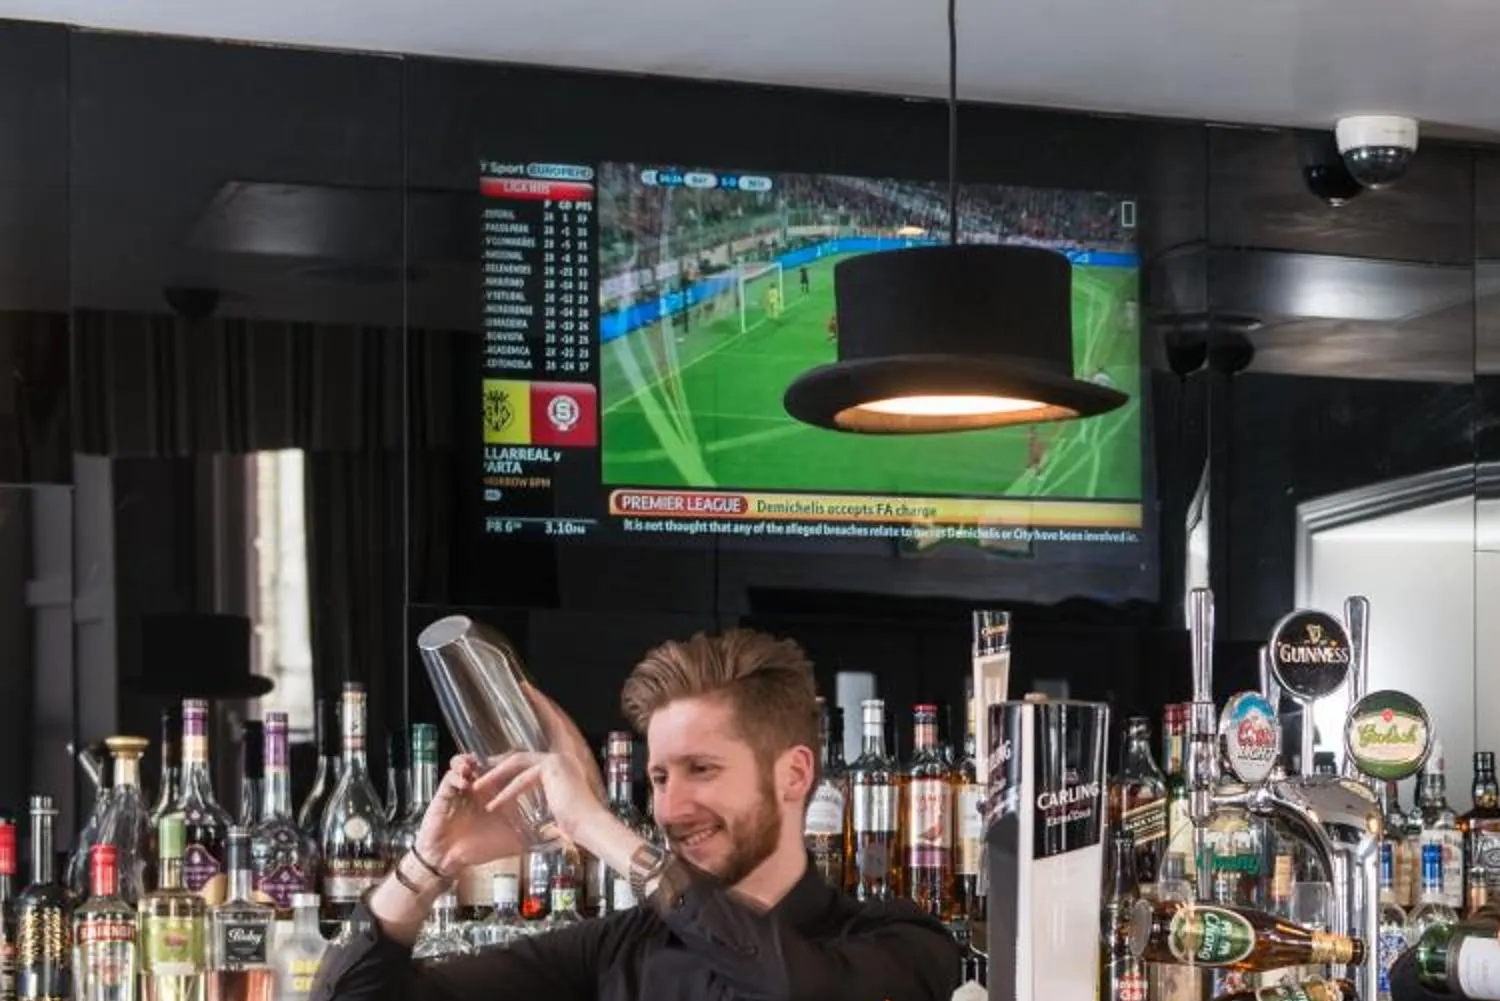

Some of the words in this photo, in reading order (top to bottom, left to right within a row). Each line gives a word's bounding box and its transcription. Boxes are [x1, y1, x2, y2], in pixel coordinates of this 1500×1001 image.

[622, 495, 685, 511] PREMIER
[687, 496, 741, 512] LEAGUE
[757, 500, 824, 515] Demichelis
[827, 504, 874, 518] accepts
[877, 503, 892, 515] FA
[895, 504, 937, 518] charge
[665, 520, 707, 534] thought
[709, 520, 731, 533] that
[733, 523, 752, 536] any
[754, 521, 765, 534] of
[767, 522, 784, 534] the
[785, 522, 822, 537] alleged
[1280, 646, 1349, 664] GUINNESS
[1037, 781, 1101, 811] CARLING
